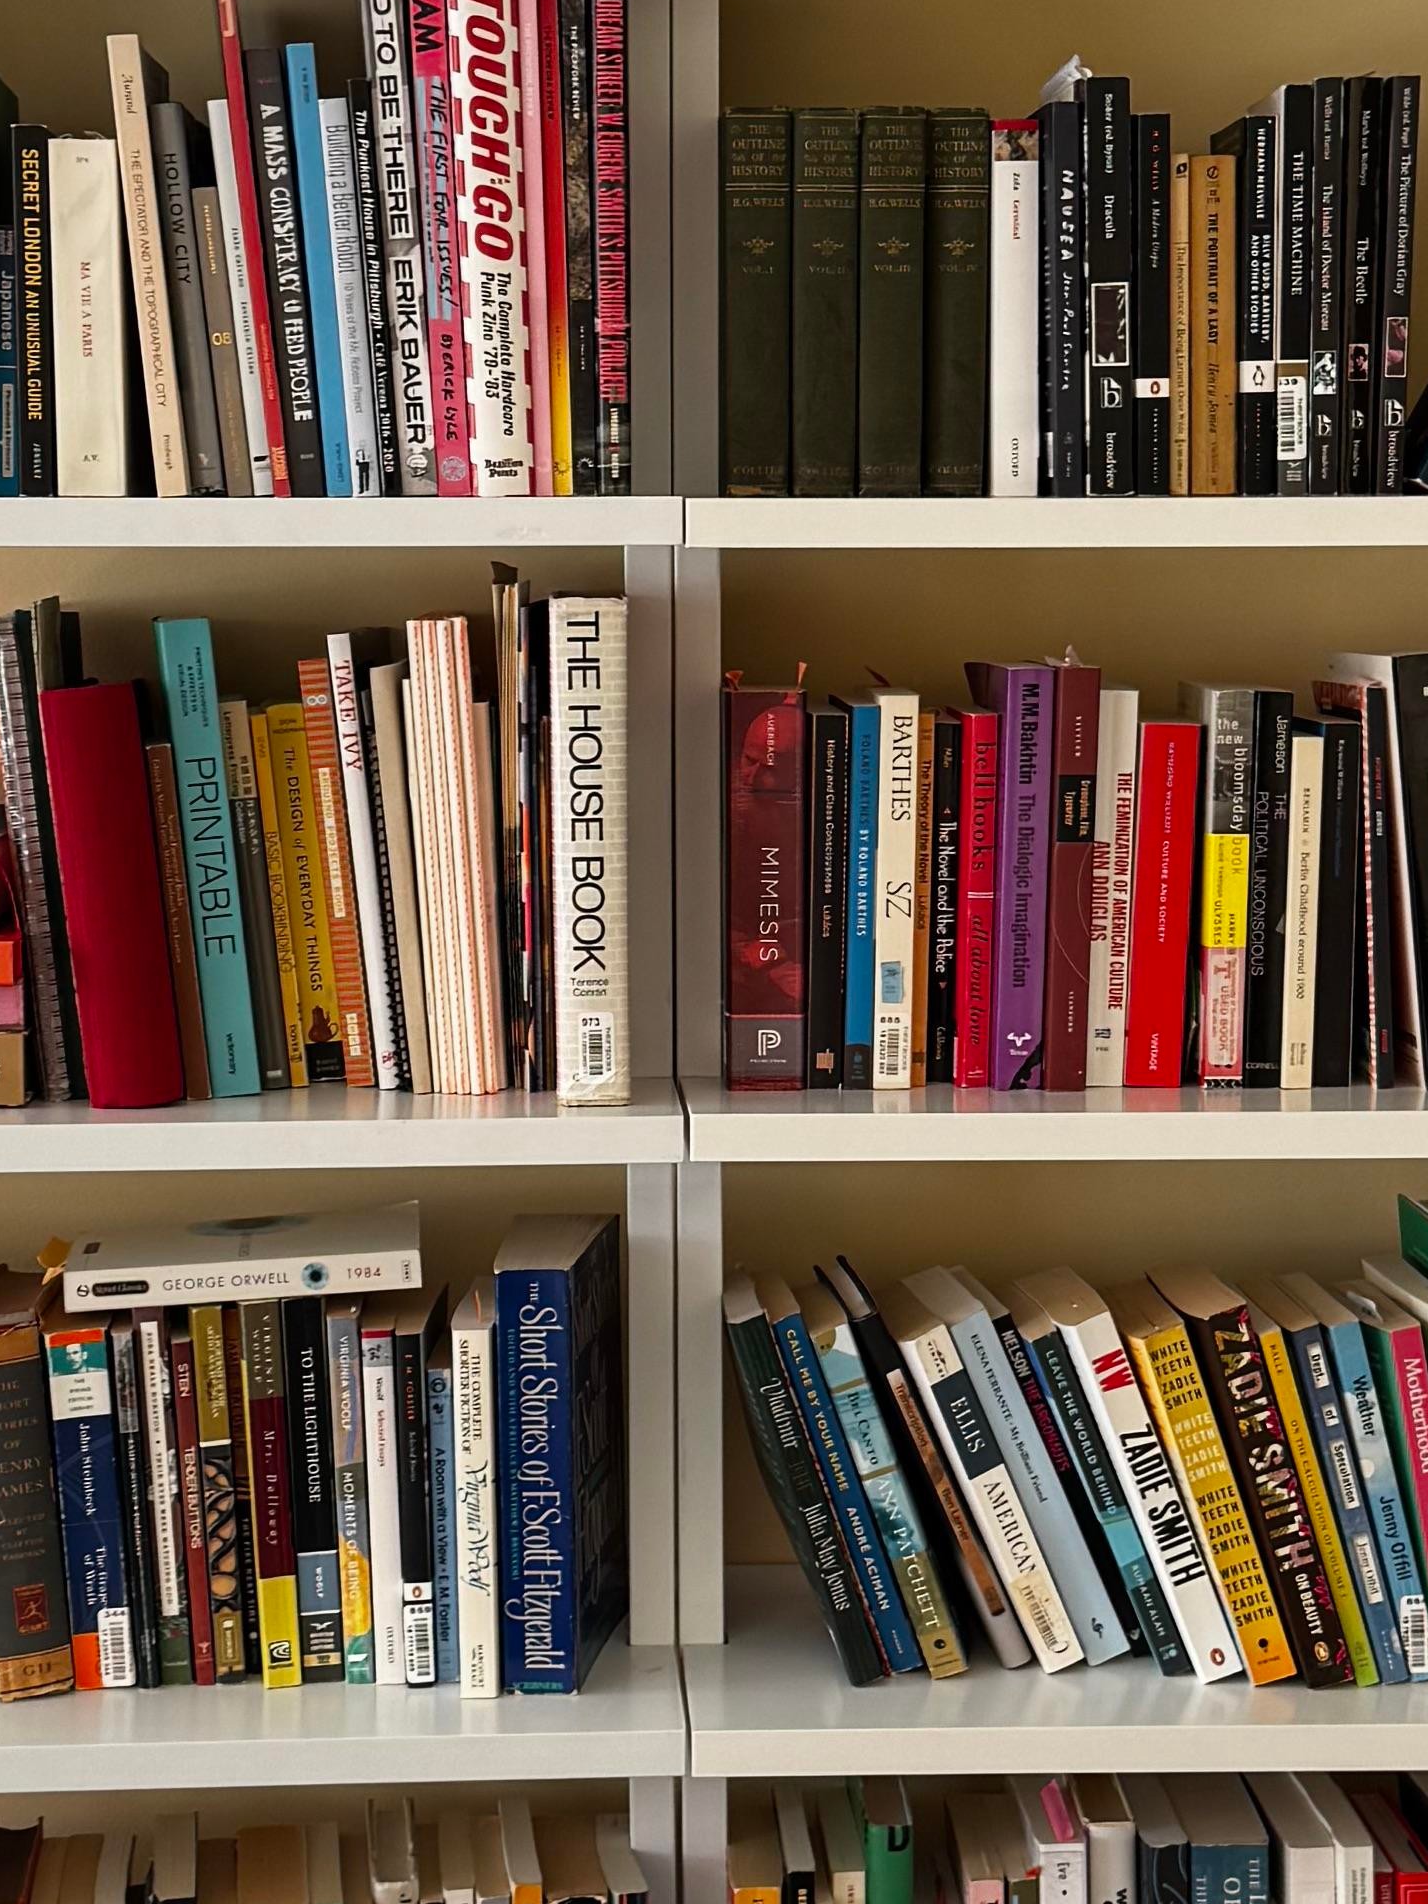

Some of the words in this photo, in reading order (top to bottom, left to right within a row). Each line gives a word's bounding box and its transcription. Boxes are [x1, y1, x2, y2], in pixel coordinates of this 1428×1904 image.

[375, 20, 396, 64] TO
[378, 72, 402, 123] BE
[21, 149, 40, 209] SECRET
[163, 152, 185, 238] HOLLOW
[383, 127, 410, 239] THERE
[23, 212, 42, 282] LONDON
[472, 196, 514, 263] GO
[1059, 170, 1074, 262] NAUSEA
[25, 288, 42, 308] AN
[173, 243, 192, 284] CITY
[394, 259, 417, 333] ERIK
[26, 311, 43, 377] UNUSUAL
[27, 381, 44, 422] GUIDE
[401, 337, 427, 448] BAUER
[567, 612, 601, 691] THE
[333, 658, 355, 724] TAKE
[341, 731, 363, 773] IVY
[568, 702, 604, 842] HOUSE
[891, 715, 913, 822] BARTHES
[184, 755, 236, 958] PRINTABLE
[571, 855, 606, 971] BOOK
[759, 846, 779, 961] MIMESIS
[162, 1277, 224, 1292] GEORGE
[230, 1271, 290, 1286] ORWELL
[346, 1266, 381, 1280] 1984
[950, 1396, 986, 1455] ELLIS
[1092, 1347, 1136, 1392] NW
[1119, 1424, 1171, 1498] ZADIE
[1148, 1499, 1206, 1588] SMITH
[983, 1481, 1039, 1578] AMERICAN
